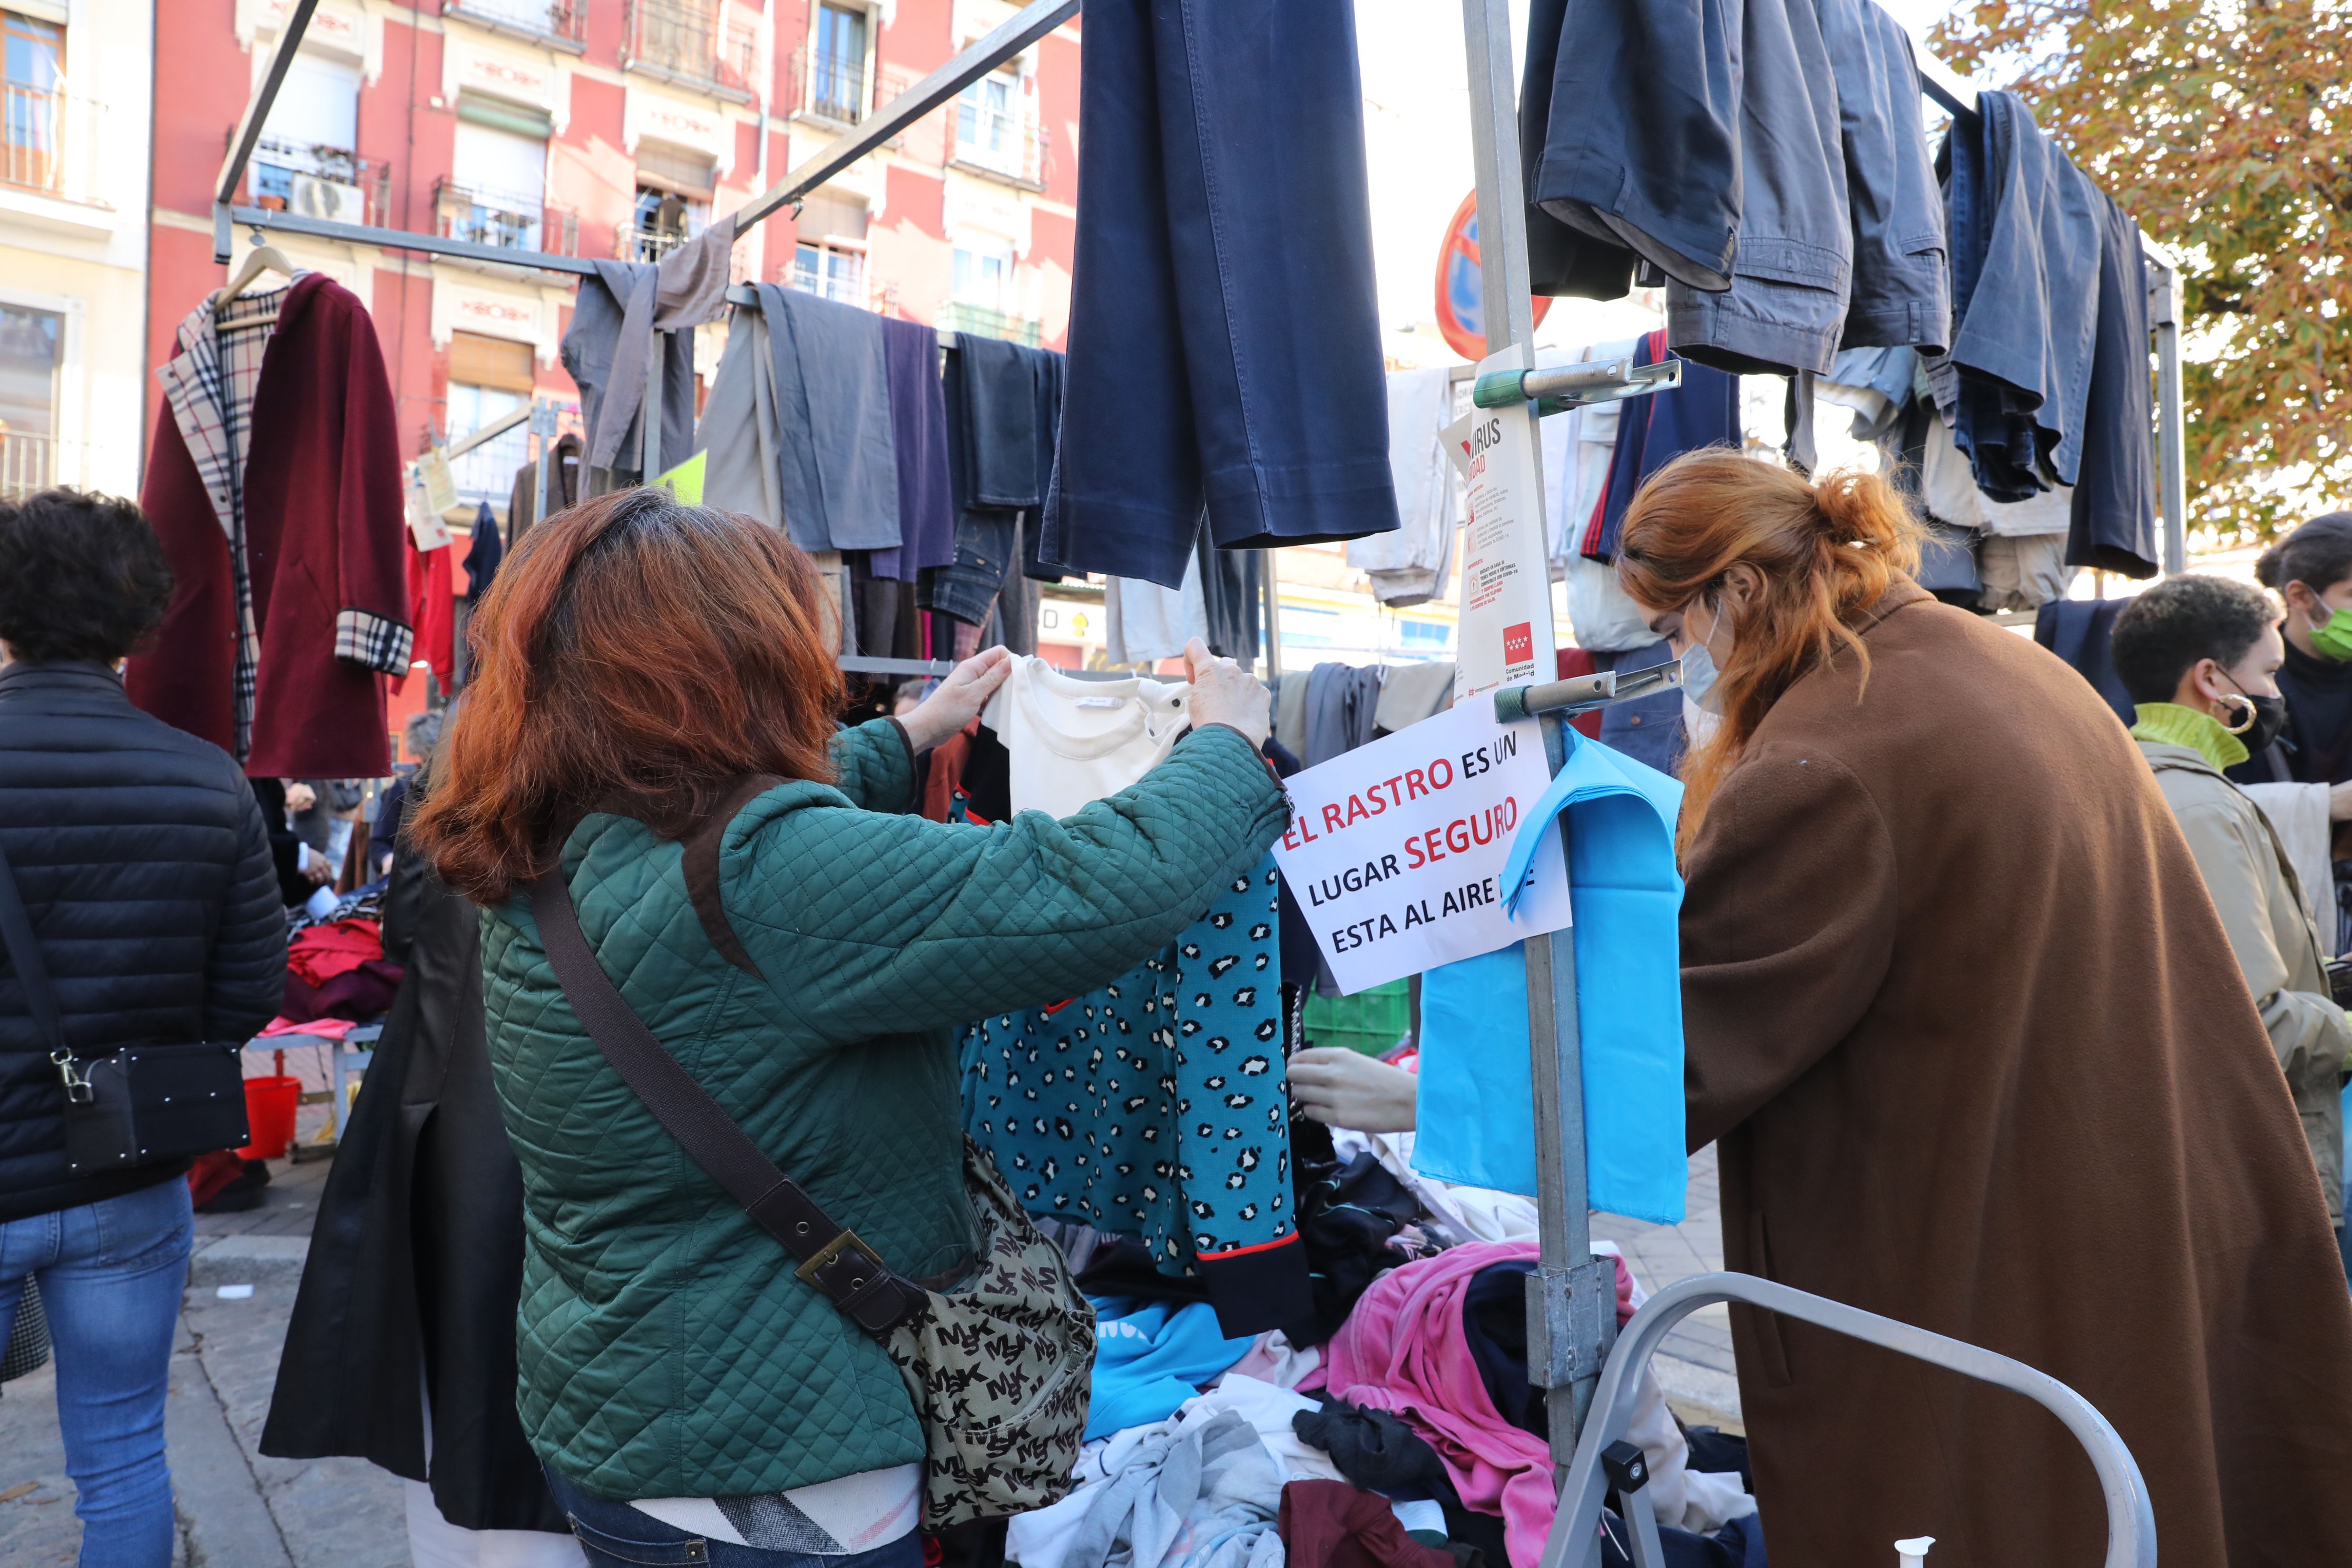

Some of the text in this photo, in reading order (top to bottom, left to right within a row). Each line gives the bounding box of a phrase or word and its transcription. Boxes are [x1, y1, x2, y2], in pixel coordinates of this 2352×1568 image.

[1503, 569, 1518, 577] COVID-19
[1506, 663, 1534, 674] Comunidad
[1282, 730, 1517, 851] EL RASTRO ES UN
[1309, 796, 1517, 907] LUGAR SEGURO
[1332, 913, 1397, 954] ESTA
[1405, 899, 1435, 930] AL
[1443, 877, 1494, 917] AIRE
